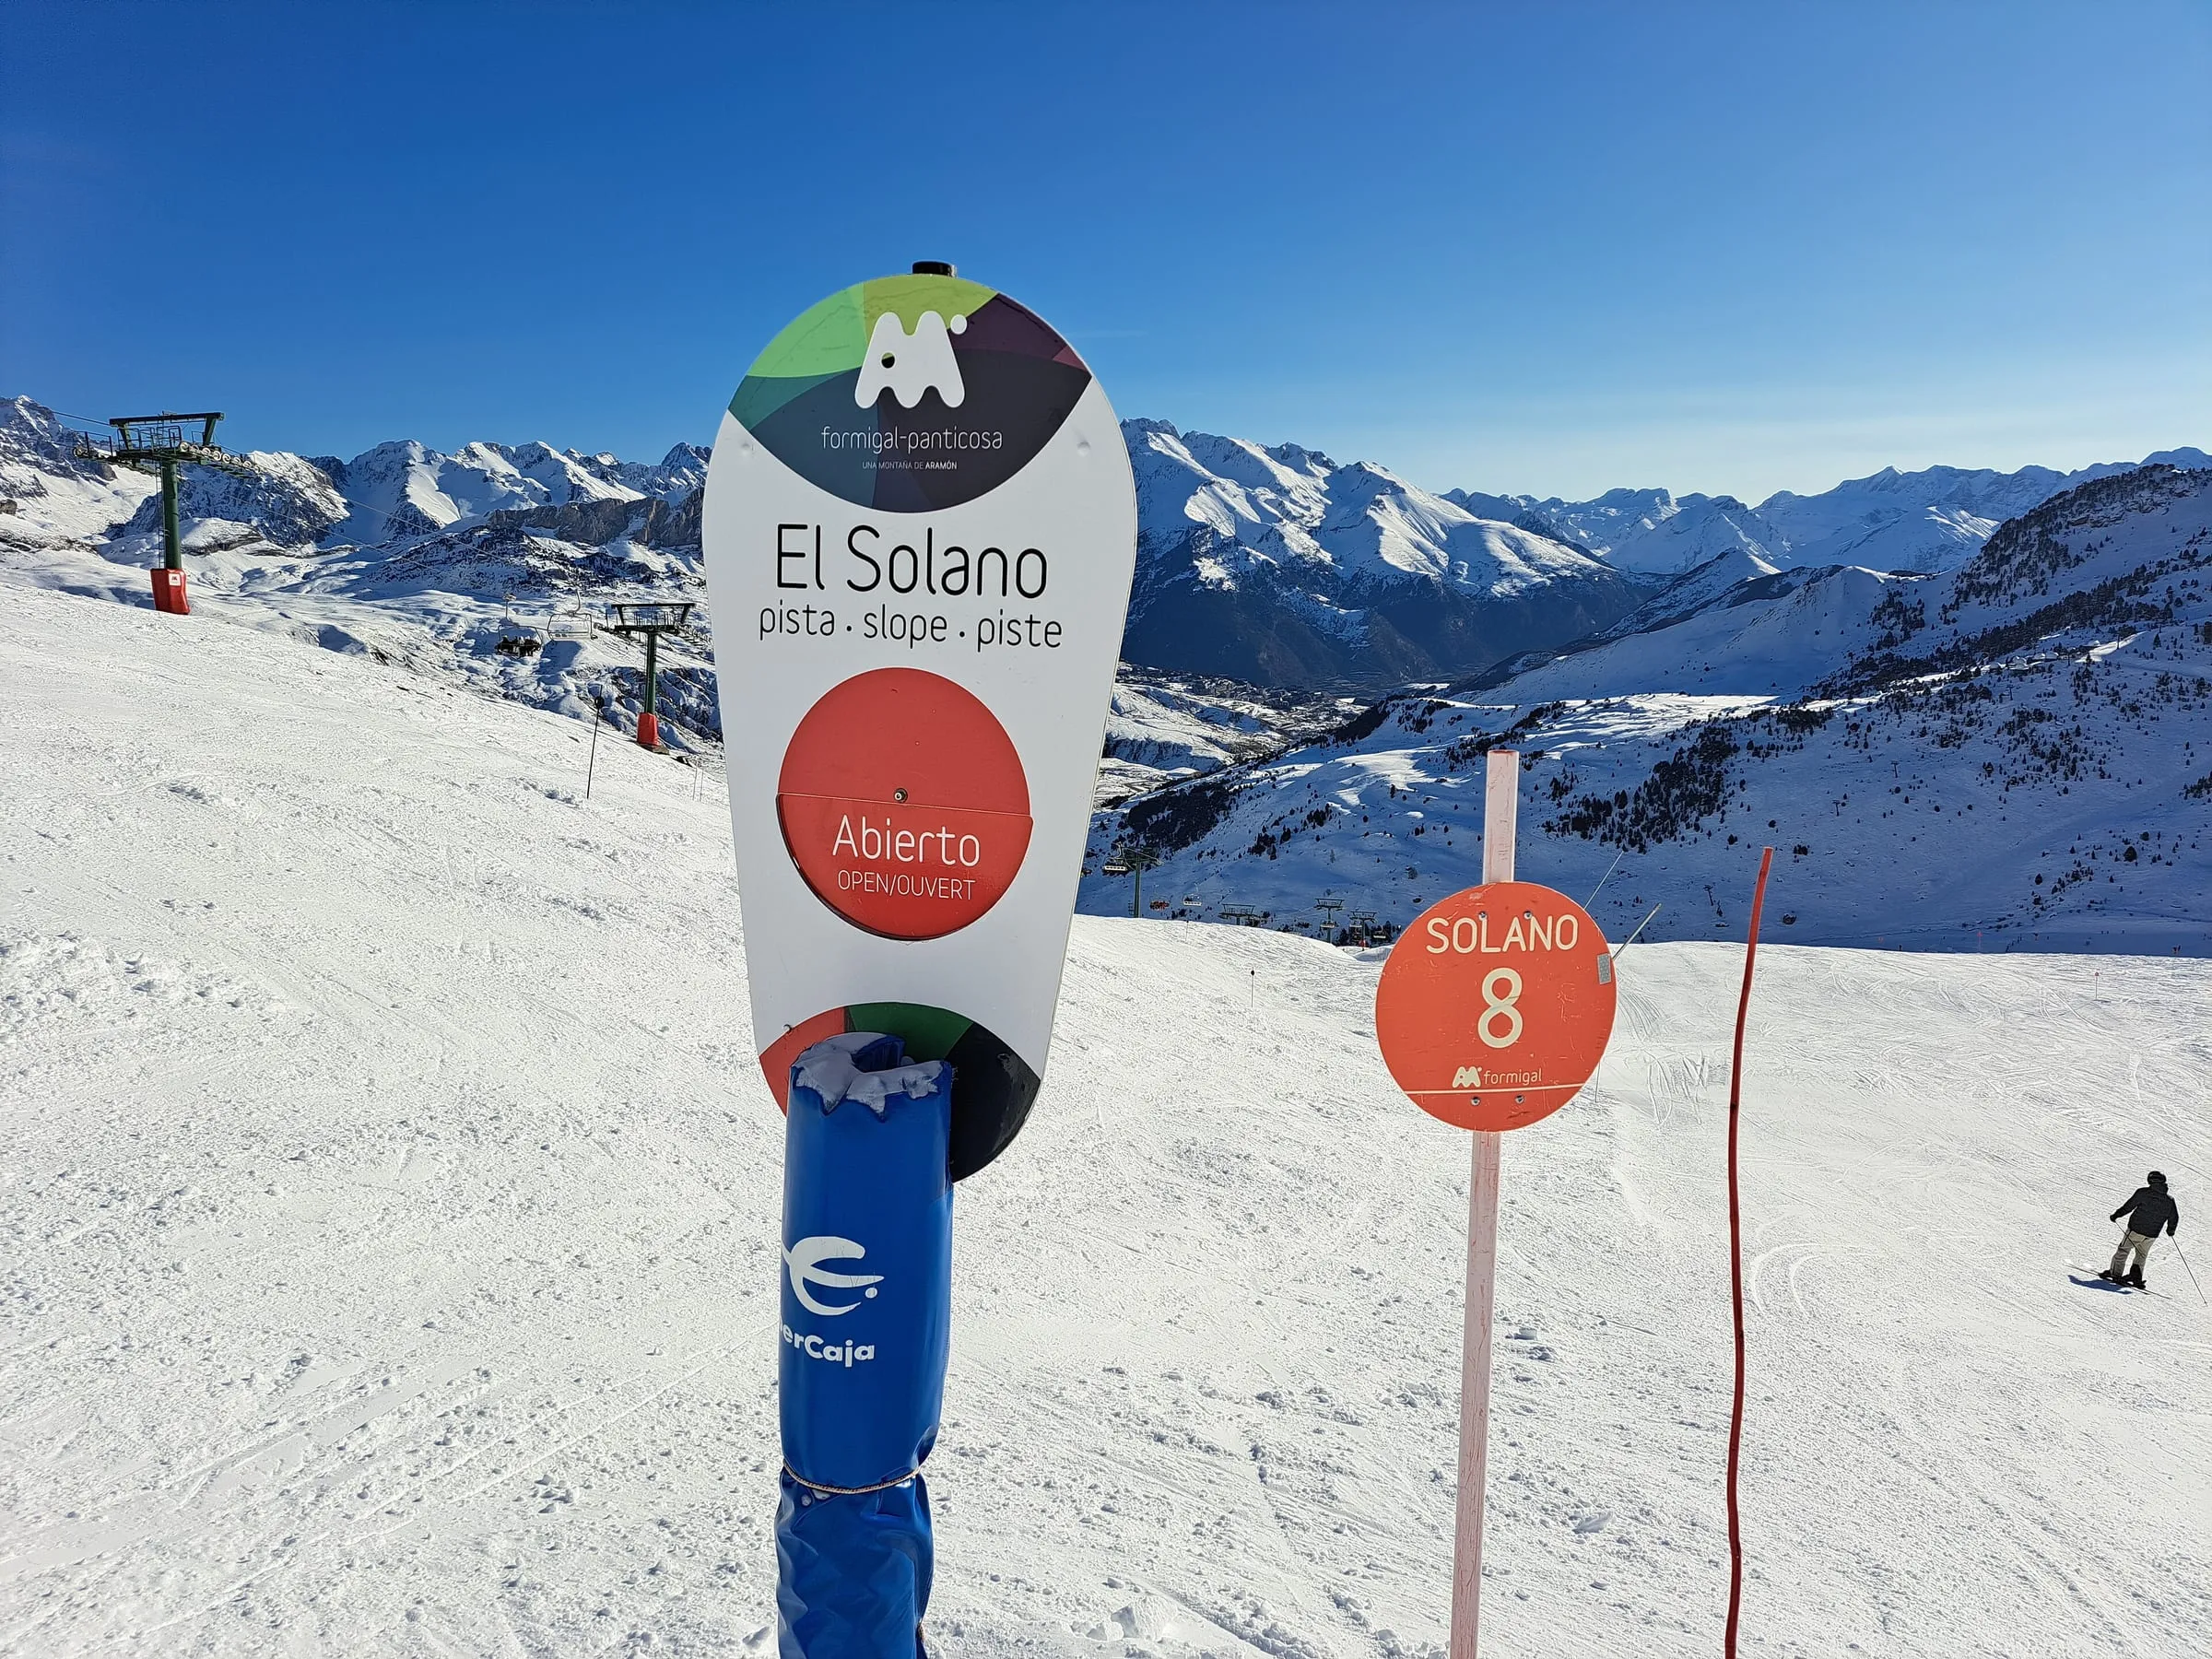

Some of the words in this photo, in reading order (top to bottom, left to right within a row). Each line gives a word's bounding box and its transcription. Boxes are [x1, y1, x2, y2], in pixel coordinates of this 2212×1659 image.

[820, 425, 1003, 454] formigal-panticosa
[862, 461, 877, 470] UNA
[878, 461, 912, 470] MONTAÑA
[914, 462, 924, 470] DE
[924, 460, 958, 470] ARAMÓN
[777, 524, 825, 591] El
[846, 524, 1047, 599] Solano
[759, 599, 835, 641] pista
[863, 603, 947, 649] slope
[977, 608, 1062, 653] piste
[832, 814, 980, 867] Abierto
[837, 869, 976, 900] OPEN/OUVERT
[1426, 913, 1579, 954] SOLANO
[1477, 967, 1524, 1049] 8
[1483, 1067, 1542, 1086] formigal
[780, 1318, 875, 1368] erCaja
